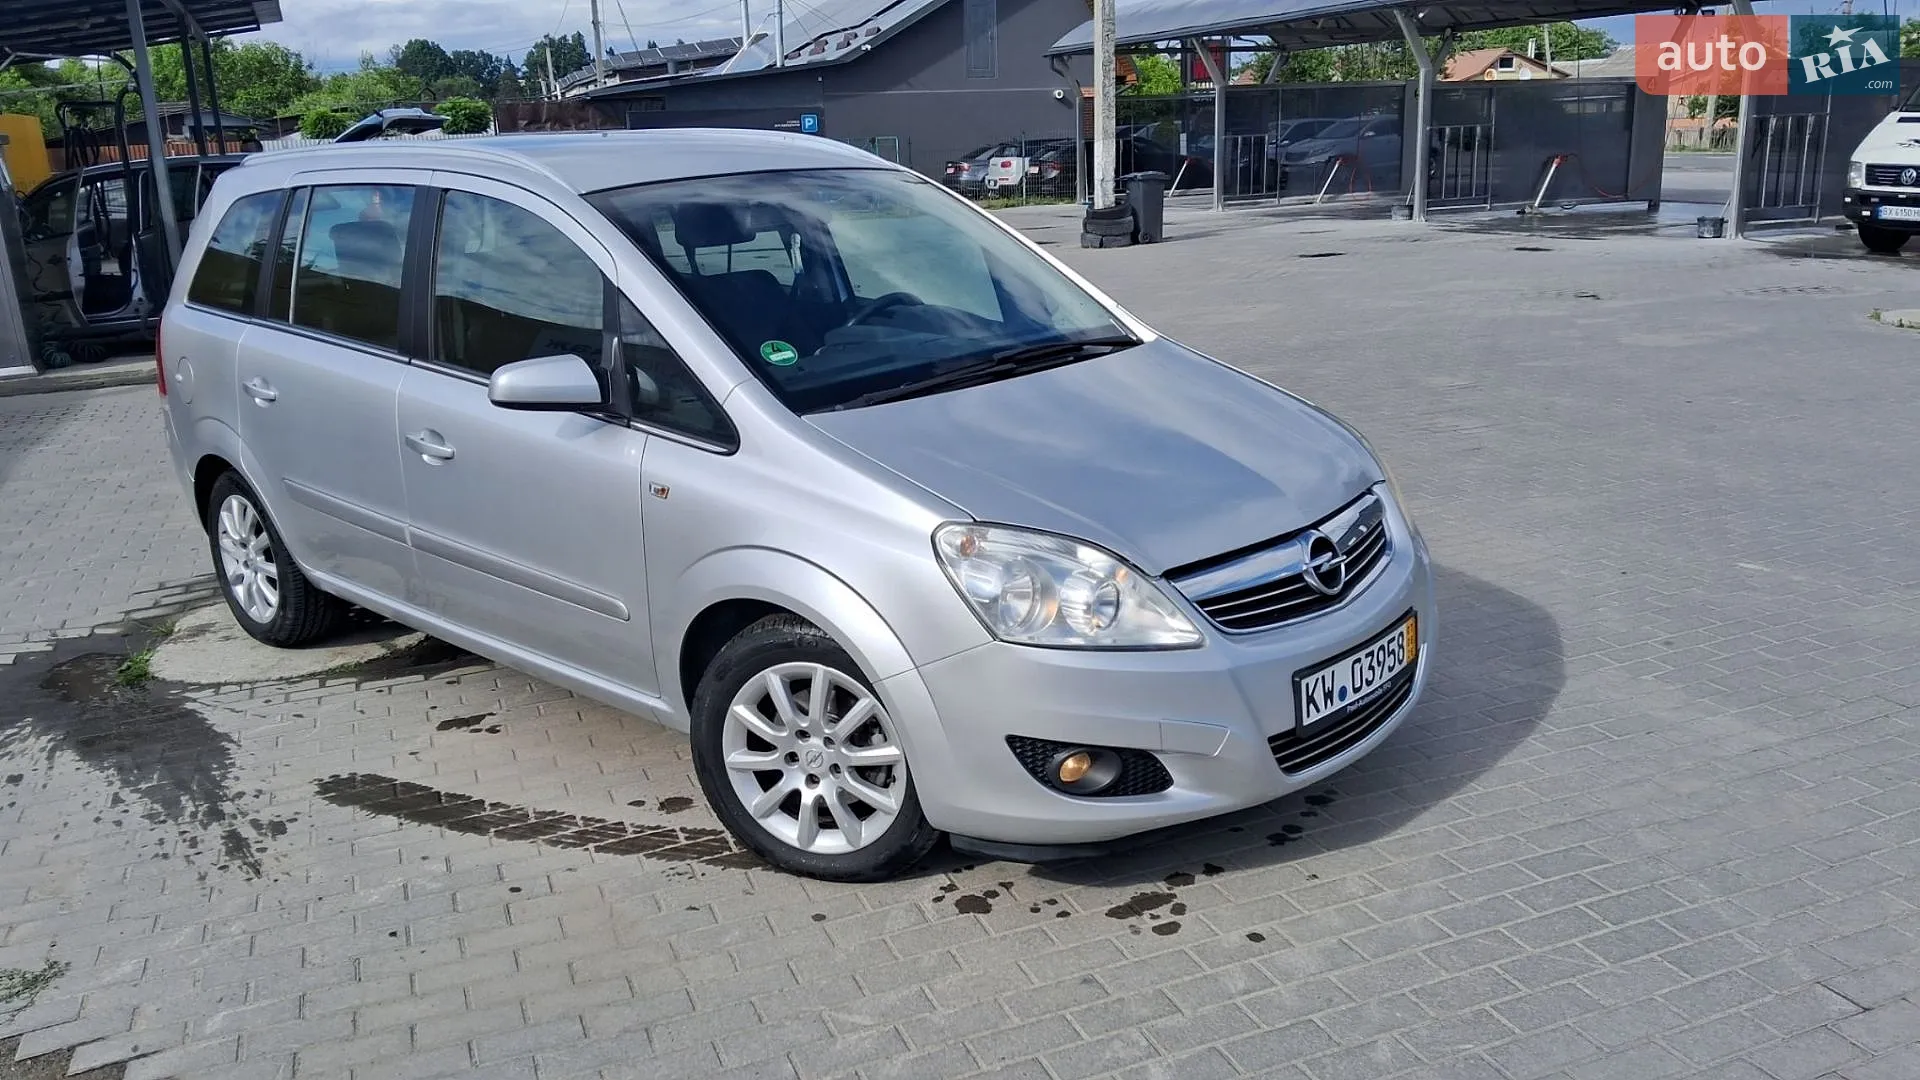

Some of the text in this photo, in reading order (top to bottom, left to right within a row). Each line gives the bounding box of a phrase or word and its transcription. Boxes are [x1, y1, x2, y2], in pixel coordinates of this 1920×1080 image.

[805, 117, 814, 129] P
[1305, 670, 1335, 718] KW
[1351, 631, 1404, 694] 03958
